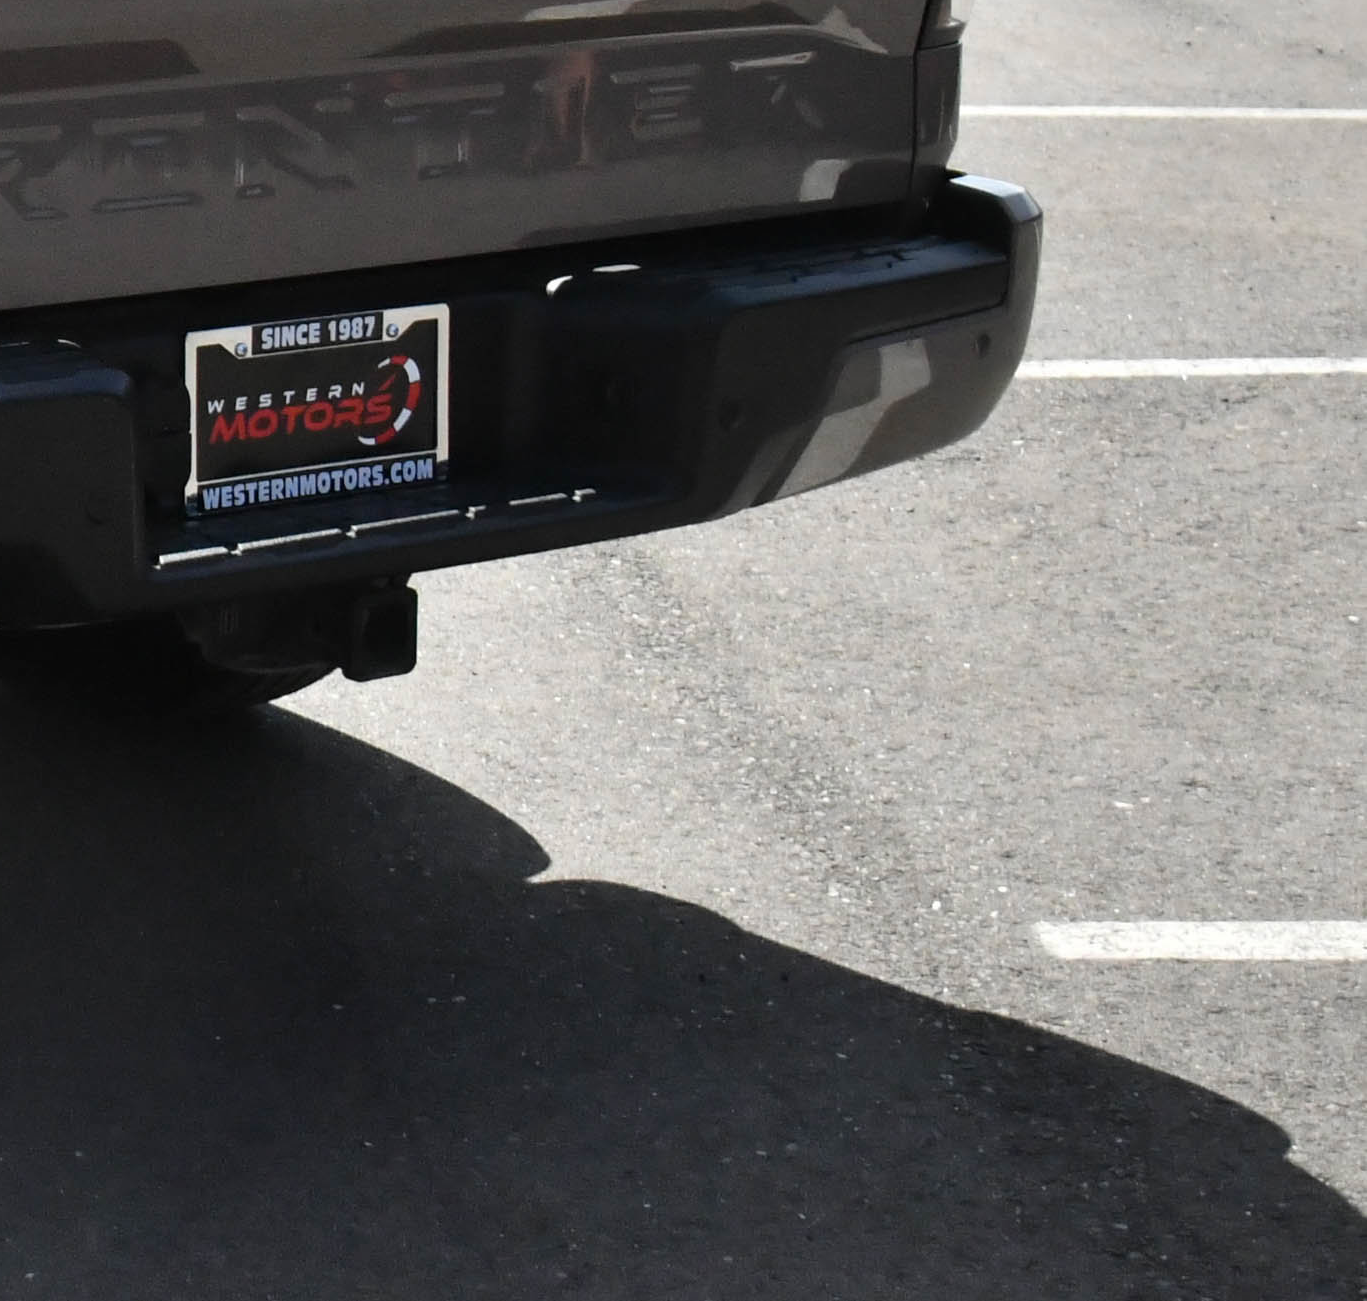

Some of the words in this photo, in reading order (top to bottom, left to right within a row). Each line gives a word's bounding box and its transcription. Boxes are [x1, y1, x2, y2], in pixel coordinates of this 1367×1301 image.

[261, 322, 322, 351] SINCE
[327, 315, 377, 343] 1987
[206, 381, 366, 415] WESTERN
[210, 393, 394, 445] MOTORS
[202, 457, 435, 511] WESTERNMOTORS.COM
